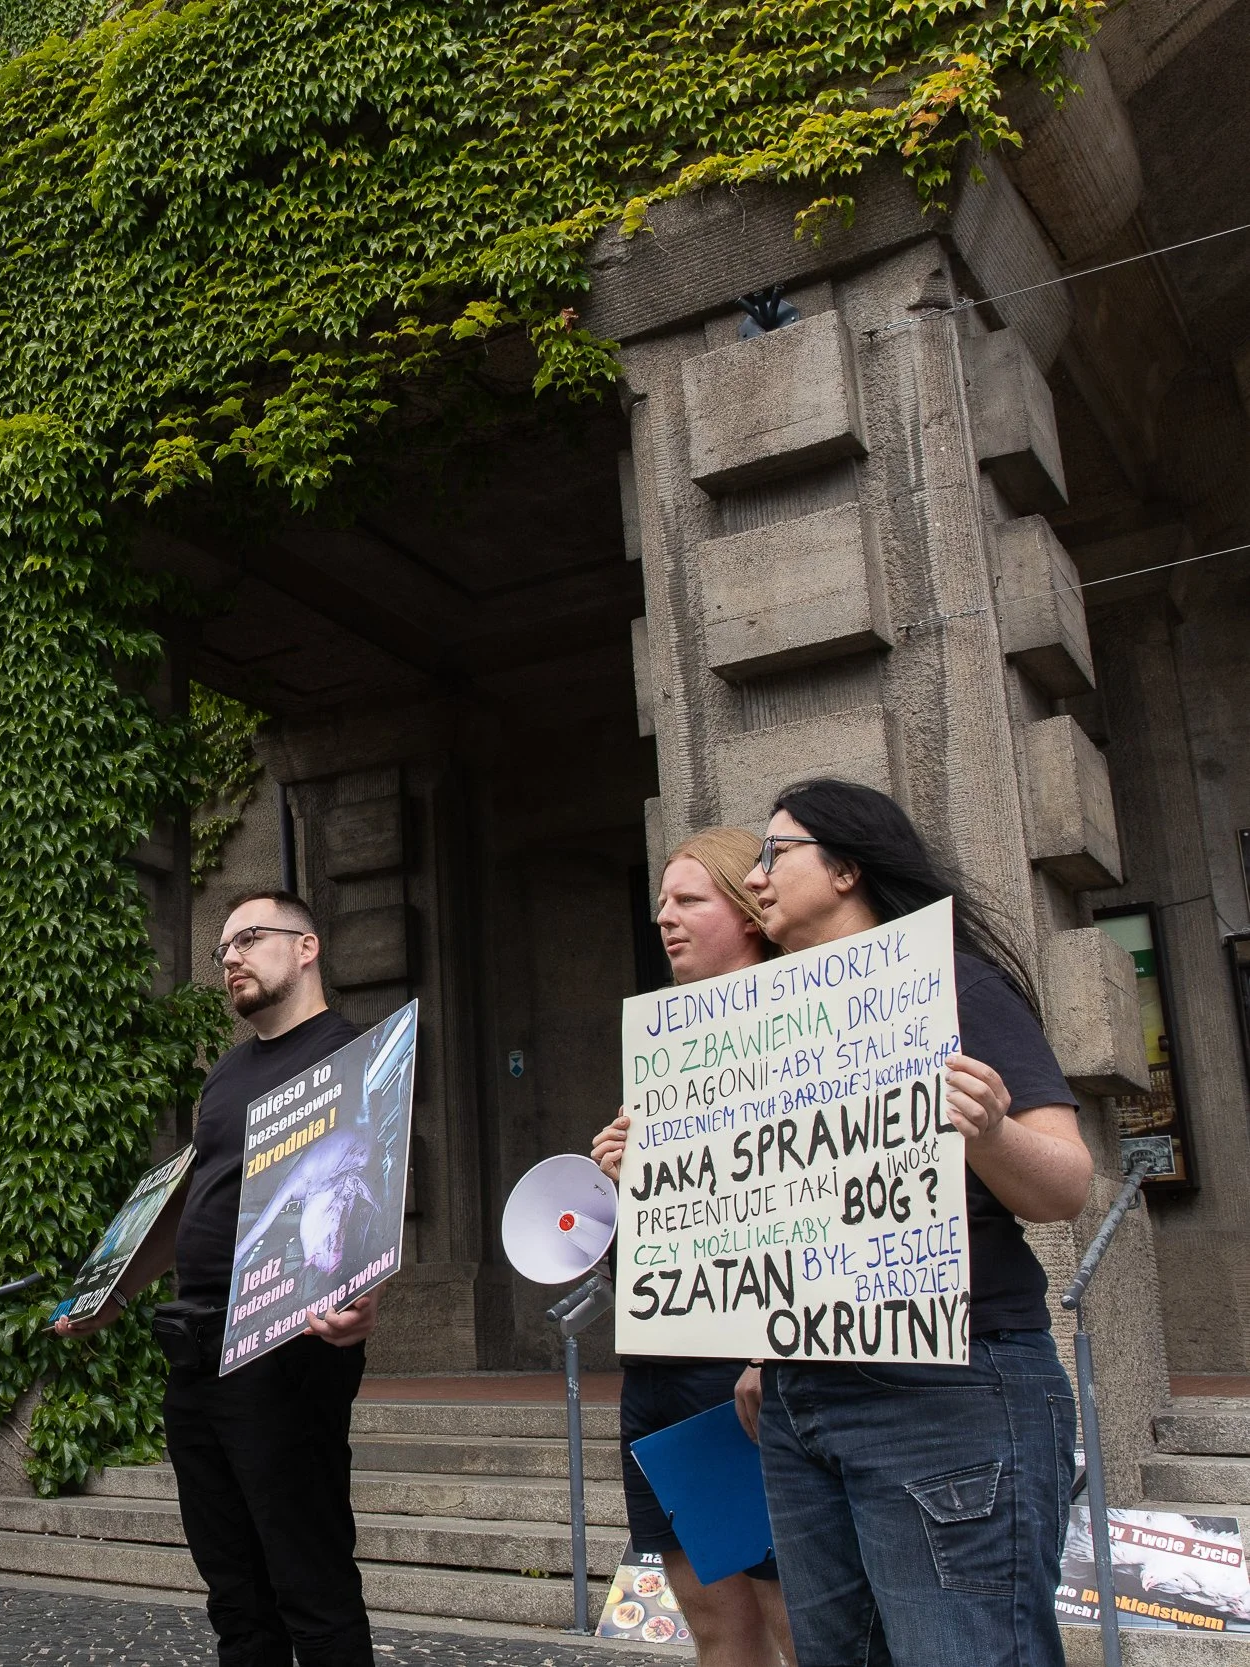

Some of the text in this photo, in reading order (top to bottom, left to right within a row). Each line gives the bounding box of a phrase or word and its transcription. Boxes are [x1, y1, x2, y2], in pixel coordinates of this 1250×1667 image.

[646, 930, 910, 1037] JEDNYCH STWORZYŁ
[634, 968, 942, 1085] DO ZBAWIENIA, DRUGICH
[837, 1021, 896, 1071] STALI
[903, 1015, 931, 1051] SIĘ
[248, 1083, 342, 1150] bezsensowna
[250, 1064, 332, 1126] mięso to
[638, 1104, 735, 1150] JEDZENIEM
[739, 1096, 777, 1124] TYCH
[779, 1067, 871, 1115] BARDZIEJ
[630, 1072, 958, 1202] JAKĄ SPRAWIEDL
[636, 1184, 777, 1238] PREZENTUJE
[784, 1166, 839, 1202] TAKI
[240, 1257, 282, 1297] Jedz
[629, 1214, 962, 1321] SZATAN BYŁ JESZCZE
[633, 1242, 678, 1266] CZY
[854, 1258, 960, 1302] BARDZIEJ
[224, 1246, 396, 1365] a NIE skatowane zwłoki
[231, 1277, 295, 1327] jedzenie
[766, 1290, 970, 1362] OKRUTNY?
[1130, 1528, 1186, 1553] Twoje
[1192, 1542, 1241, 1565] życie
